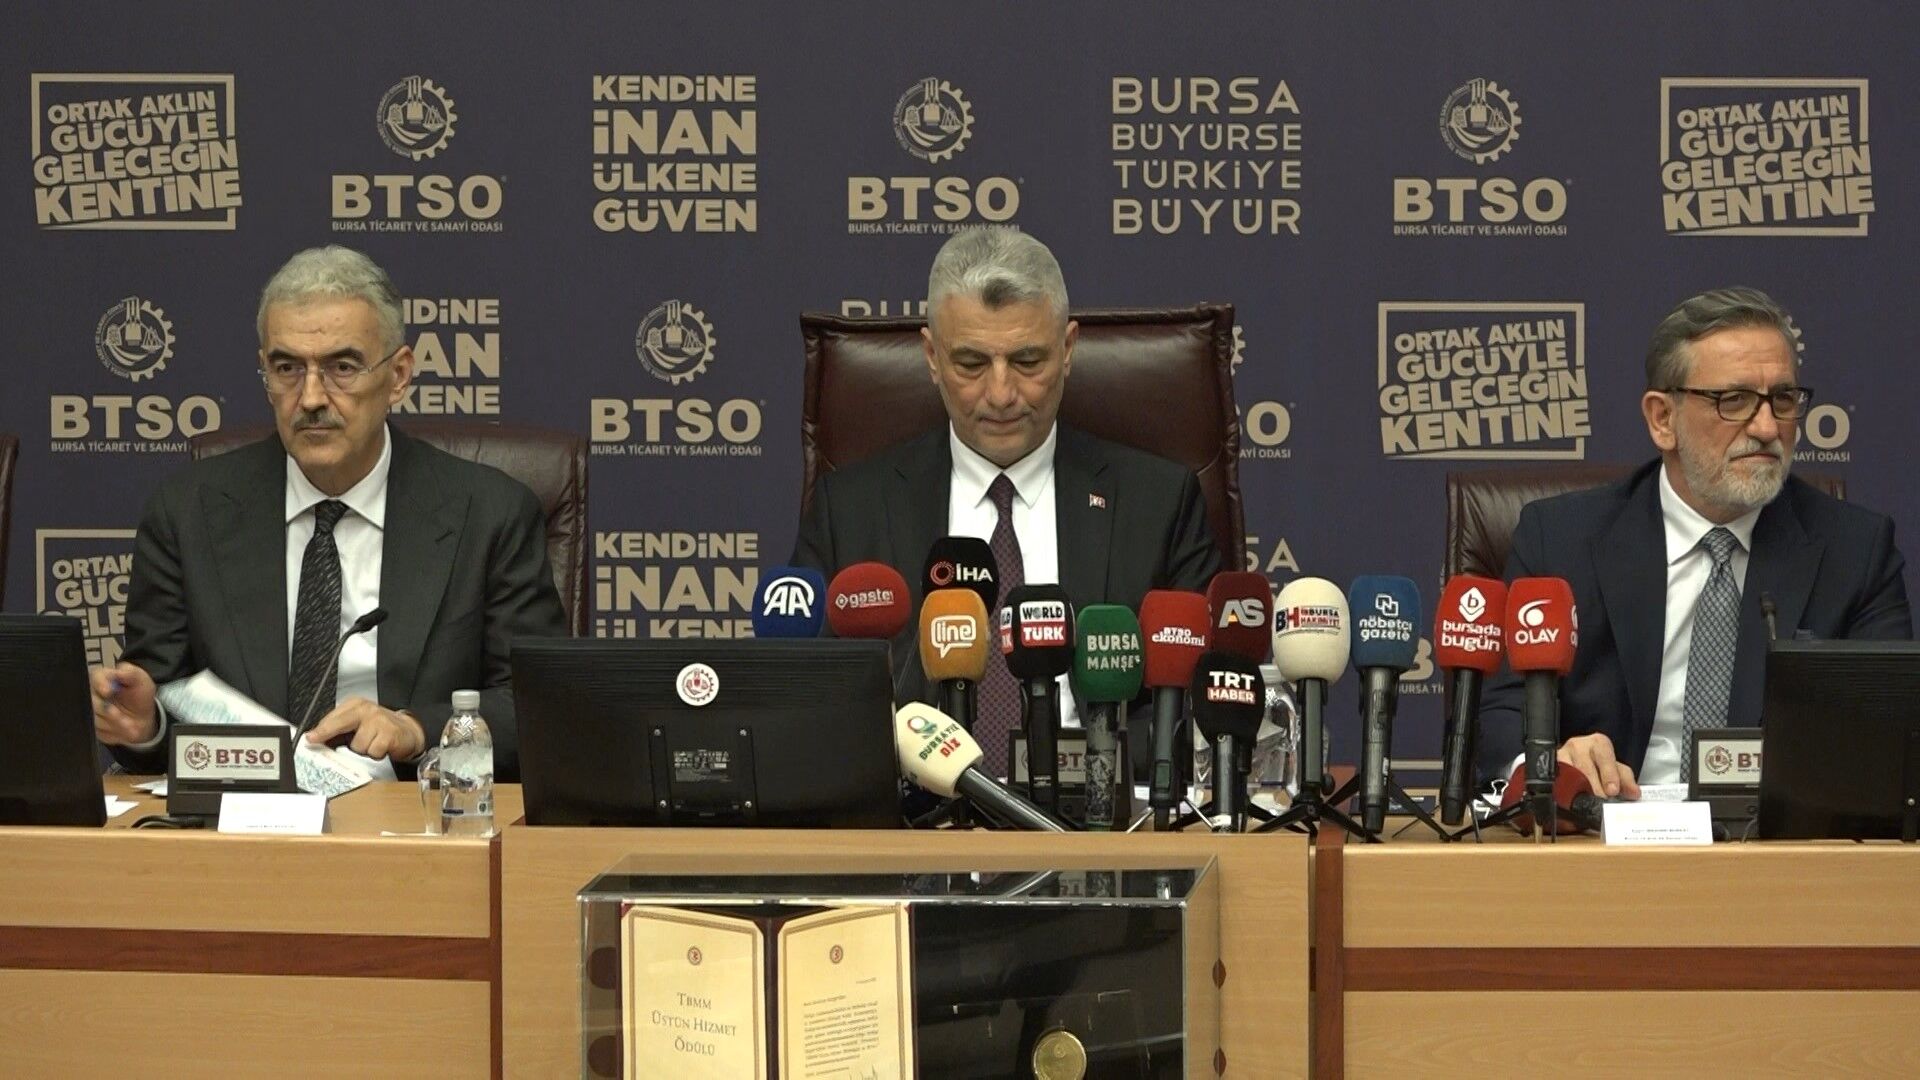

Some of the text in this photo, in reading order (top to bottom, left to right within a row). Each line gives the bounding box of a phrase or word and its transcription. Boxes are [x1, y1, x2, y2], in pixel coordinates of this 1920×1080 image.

[47, 90, 216, 125] ORTAK AKLIN
[1112, 76, 1300, 114] BURSA
[1677, 95, 1849, 129] ORTAK AKLIN
[1112, 123, 1302, 151] BÜYÜRSE
[593, 162, 757, 192] ÜLKENE
[331, 174, 503, 220] BTSO
[848, 176, 1020, 222] BTSO
[1393, 177, 1567, 223] BTSO
[332, 220, 503, 232] BURSA TİCARET VE SANAYİ ODASI
[593, 198, 757, 232] GÜVEN
[848, 223, 883, 234] BURSA
[886, 222, 929, 234] TİCARET
[931, 223, 945, 234] VE
[1113, 198, 1301, 235] BÜYÜR
[1393, 223, 1567, 236] BURSA TİCARET VE SANAYİ ODASI
[1394, 318, 1566, 353] ORTAK AKLIN
[412, 332, 500, 378] AN
[390, 384, 500, 414] KENE
[50, 395, 221, 440] BTSO
[591, 399, 762, 443] BTSO
[51, 442, 86, 452] BURSA
[134, 442, 147, 452] VE
[149, 440, 187, 452] SANAYİ
[591, 444, 762, 456] BURSA TİCARET VE SANAYİ ODASI
[1259, 449, 1291, 458] ODASI
[1818, 452, 1850, 462] ODASI
[763, 577, 815, 618] AA
[1218, 598, 1266, 628] AS
[1442, 619, 1502, 637] bursada
[1087, 633, 1140, 652] BURSA
[1441, 633, 1501, 652] bugün
[1515, 628, 1560, 645] OLAY
[1208, 687, 1256, 704] HABER
[1209, 671, 1256, 690] TRT
[215, 749, 275, 765] BTSO
